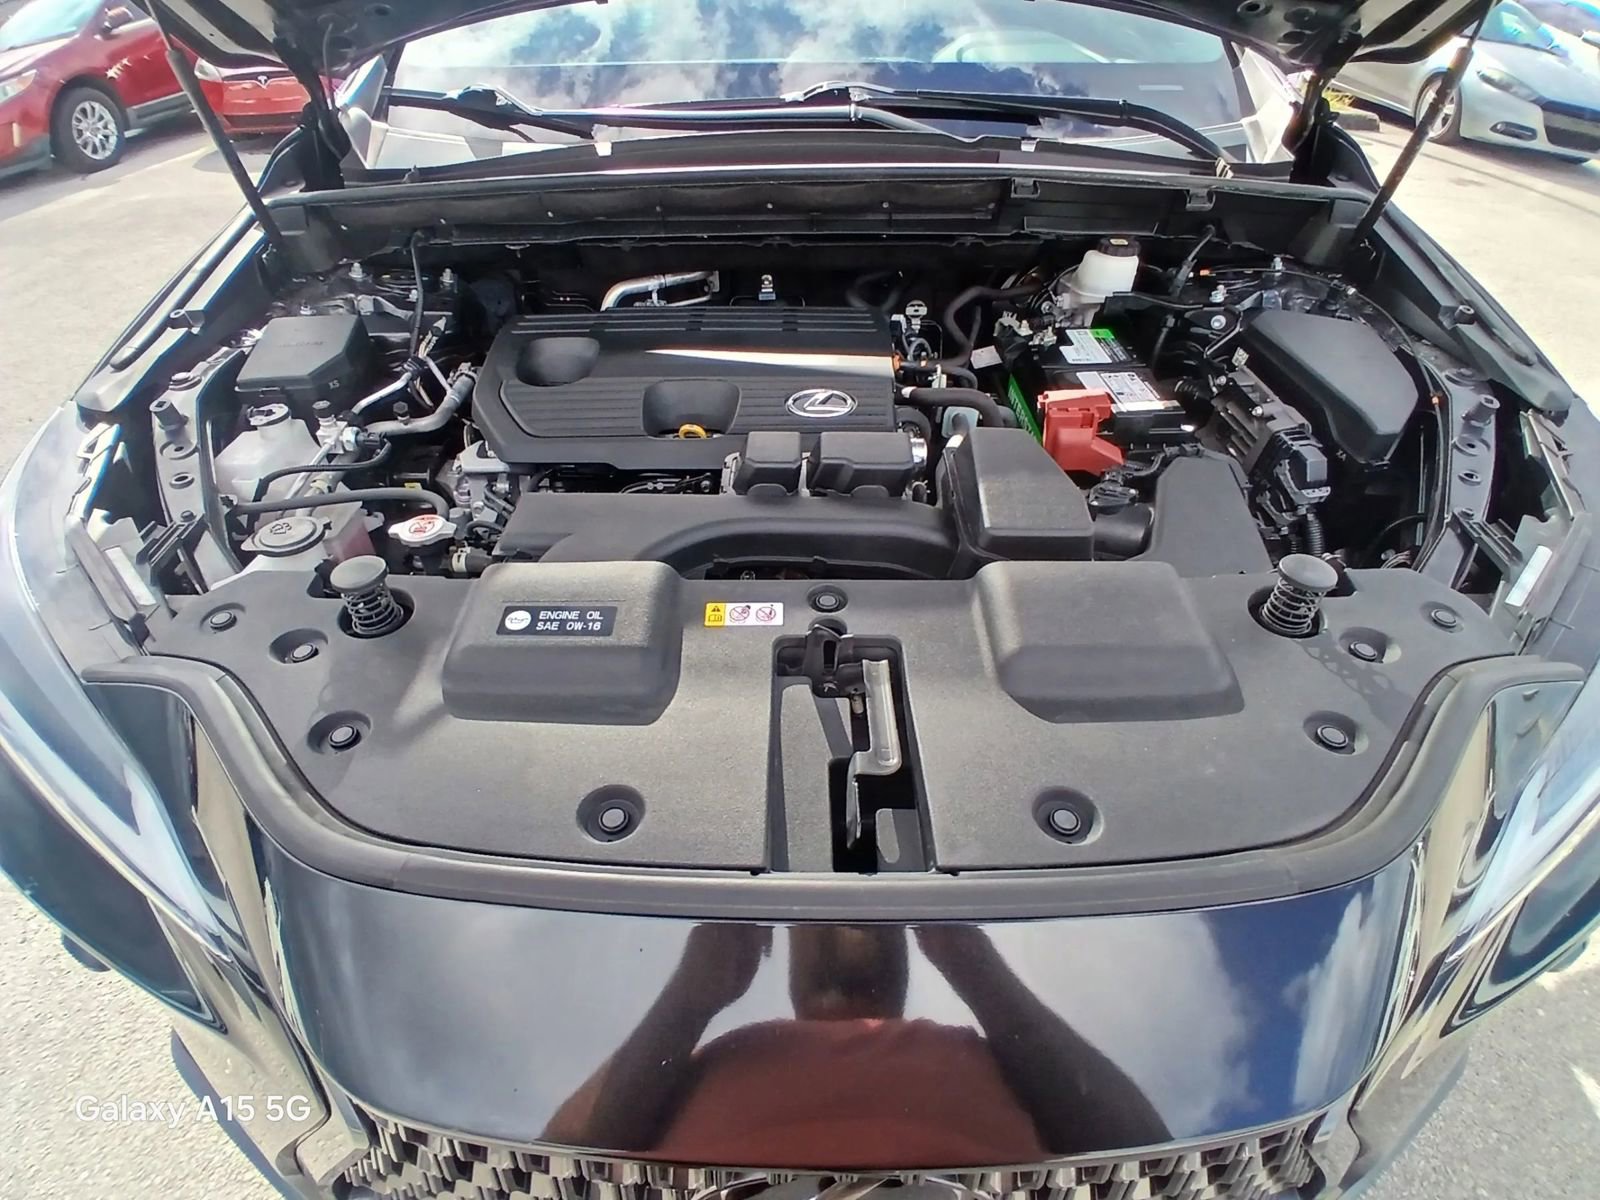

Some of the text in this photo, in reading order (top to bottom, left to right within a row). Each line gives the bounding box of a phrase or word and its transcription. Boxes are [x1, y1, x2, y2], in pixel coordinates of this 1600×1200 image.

[539, 610, 603, 620] ENGINE OIL
[536, 621, 601, 631] SAE 0W-16
